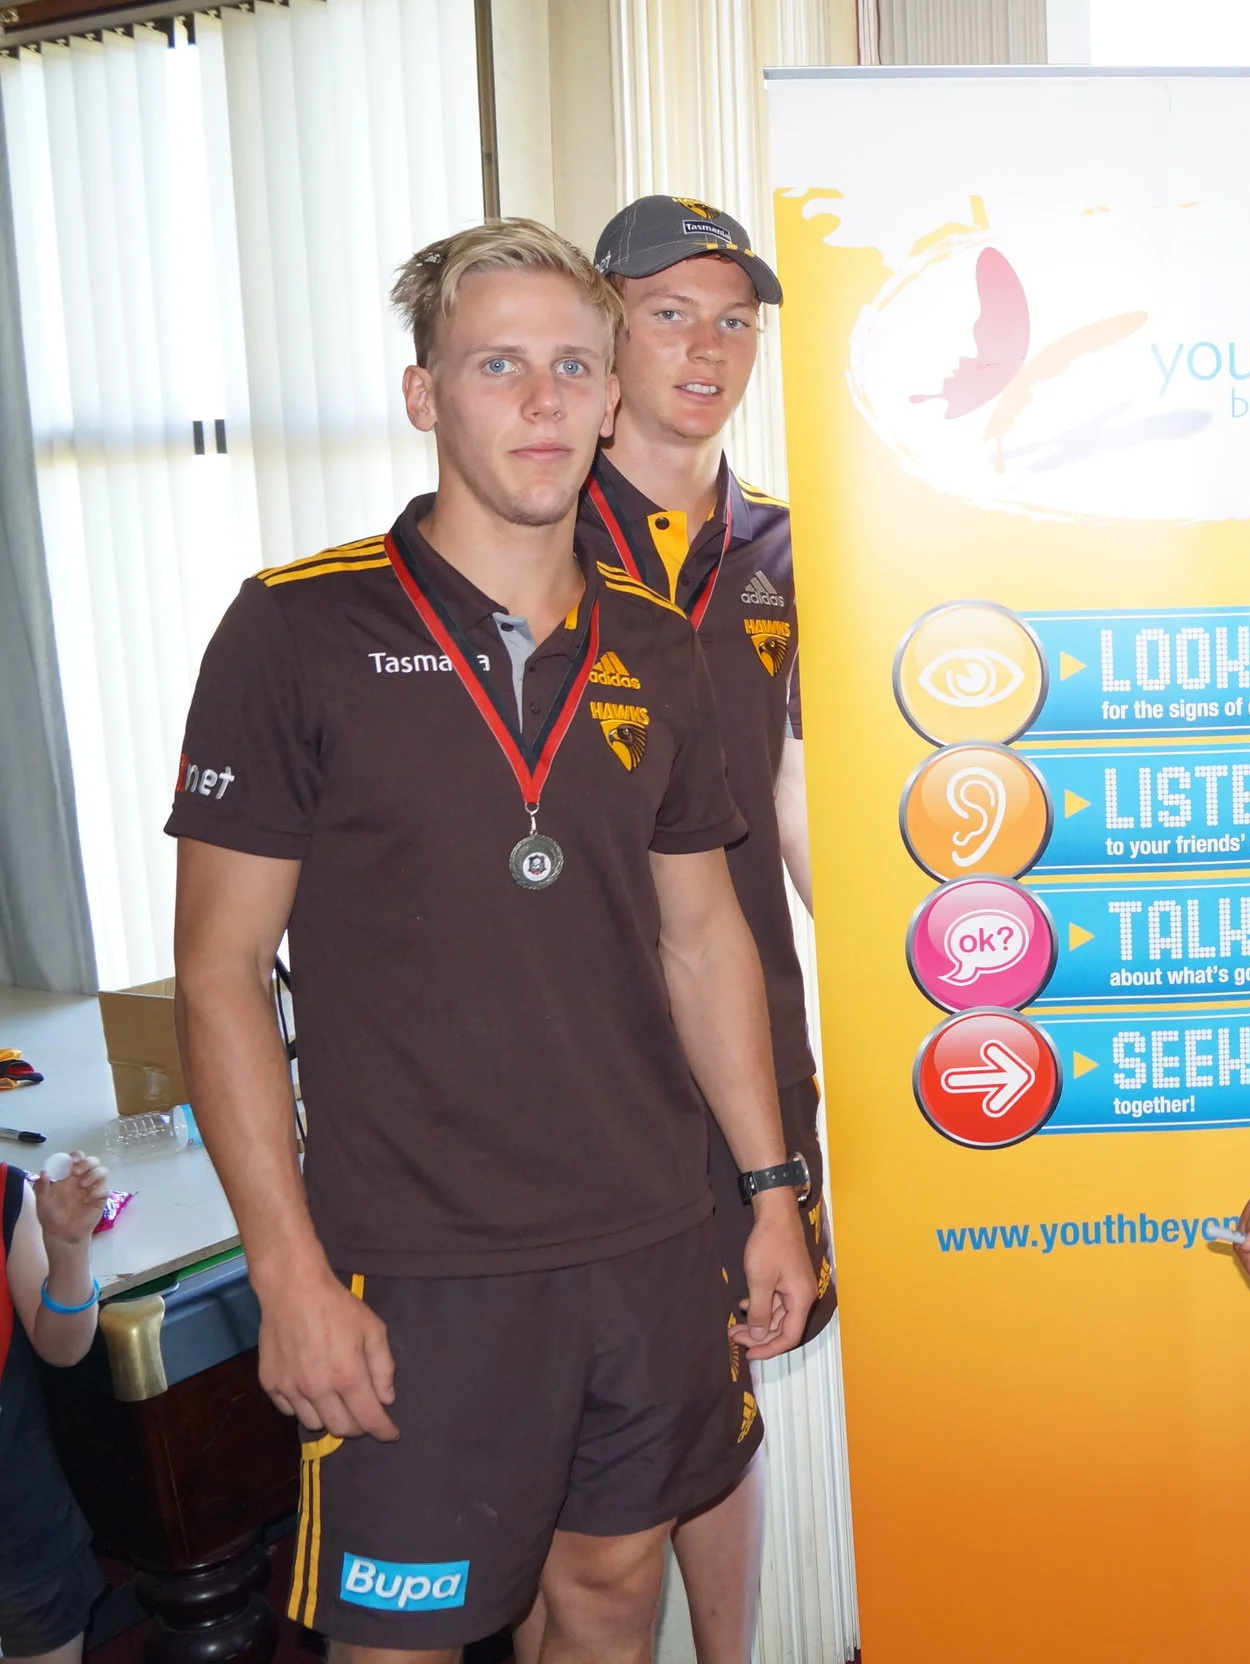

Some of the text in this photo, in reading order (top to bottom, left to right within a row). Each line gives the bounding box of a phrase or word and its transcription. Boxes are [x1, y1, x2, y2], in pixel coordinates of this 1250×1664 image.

[685, 223, 730, 240] Tasmania
[741, 592, 785, 607] adidas
[744, 619, 791, 637] HAWKS
[369, 652, 491, 674] Tasmaa
[1100, 626, 1250, 692] LOOK
[588, 671, 641, 690] adidas
[589, 701, 650, 726] HAWKS
[1101, 700, 1128, 719] for
[1134, 700, 1164, 719] the
[1169, 699, 1219, 721] signs
[1224, 697, 1243, 716] of
[1105, 837, 1124, 855] to
[1129, 838, 1171, 858] your
[1176, 833, 1246, 853] friends'
[959, 926, 1014, 953] ok?
[1110, 967, 1162, 986] about
[1168, 965, 1229, 985] what's
[1113, 1027, 1250, 1089] SEEK
[1113, 1095, 1195, 1118] together!
[345, 1557, 462, 1609] Bupa
